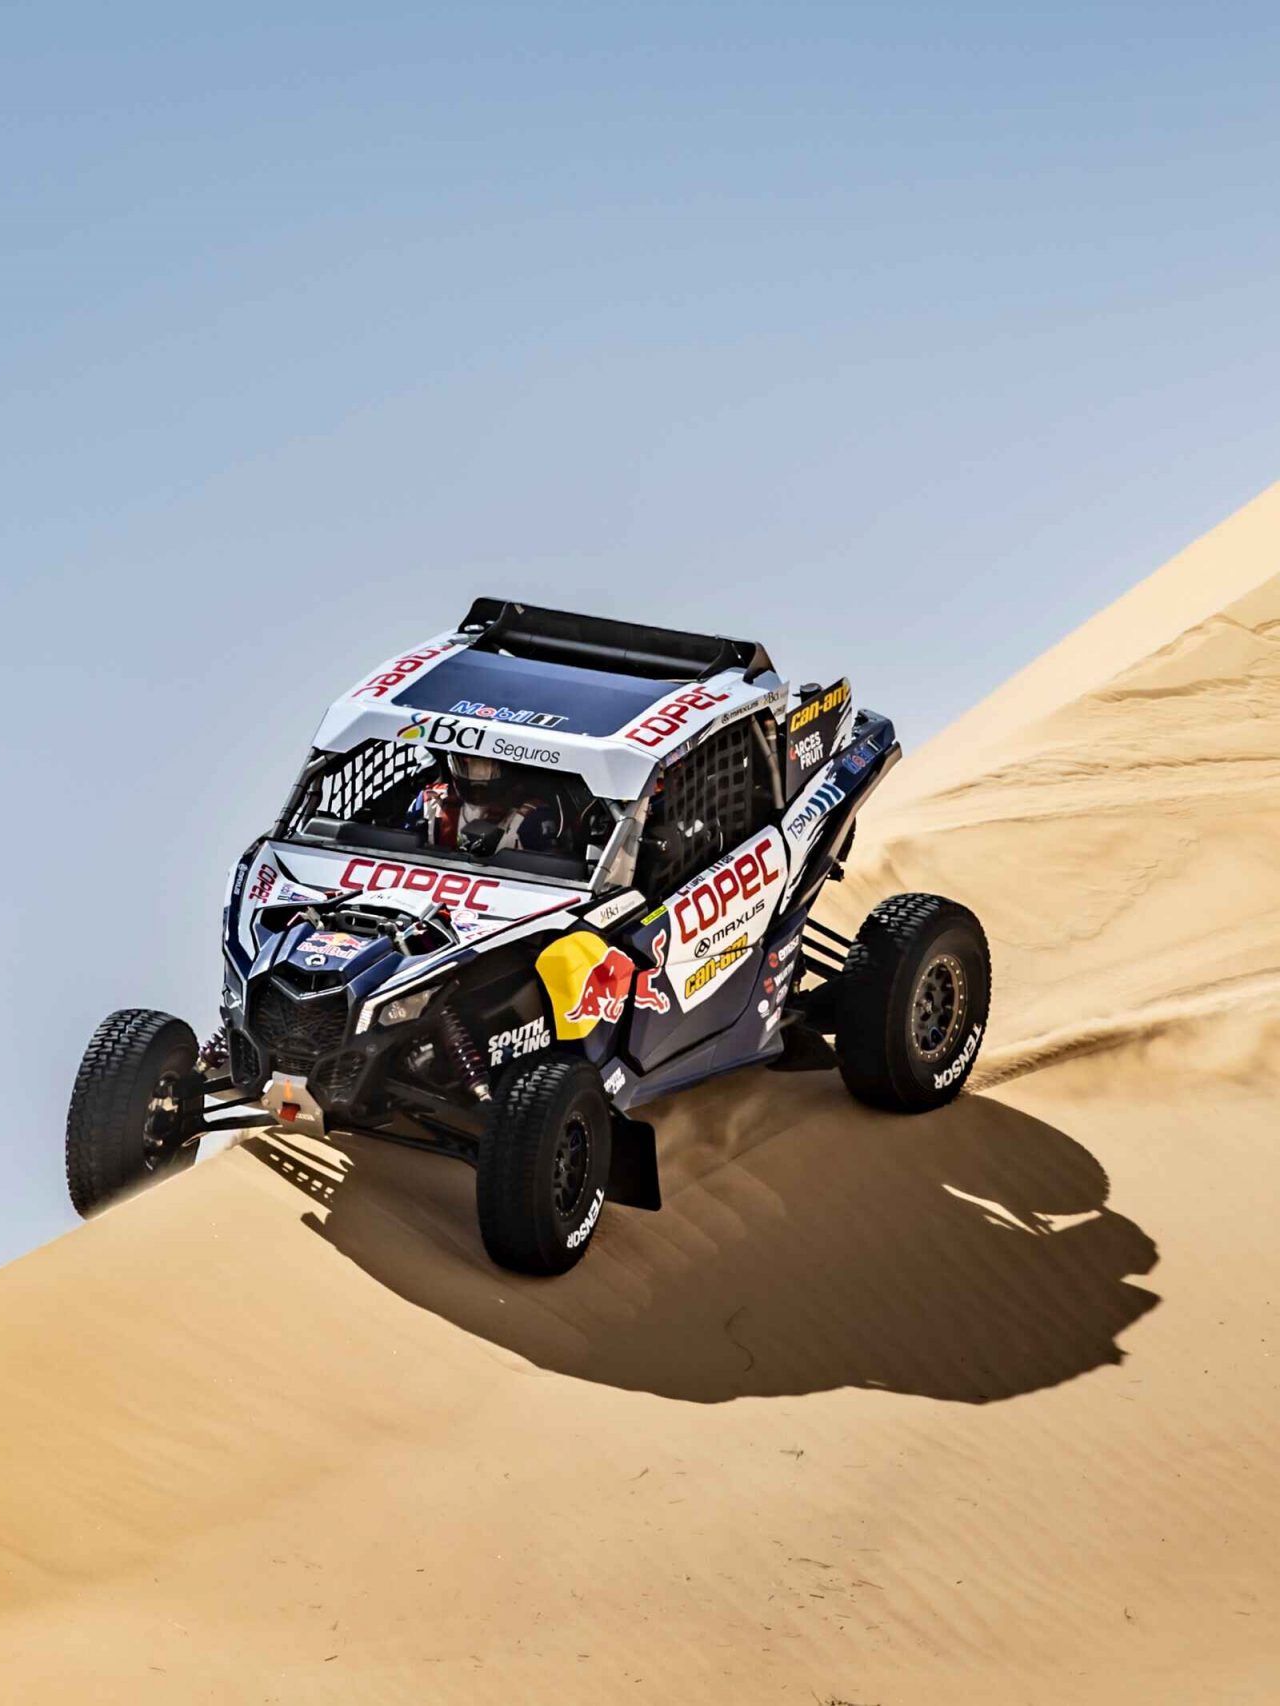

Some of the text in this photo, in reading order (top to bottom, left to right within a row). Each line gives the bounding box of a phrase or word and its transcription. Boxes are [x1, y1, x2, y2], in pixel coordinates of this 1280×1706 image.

[351, 644, 453, 698] OPEC
[449, 700, 535, 722] Mobil
[789, 683, 850, 733] can-am
[427, 716, 561, 764] Bci Seguros
[800, 743, 824, 770] FRUIT
[786, 805, 817, 840] TSM
[712, 898, 765, 944] MAXUS
[684, 932, 748, 999] can-am
[487, 1015, 545, 1052] SOUTH
[490, 1029, 551, 1067] RCING
[933, 1022, 983, 1089] TENSOR
[566, 1188, 605, 1248] TENSOR
